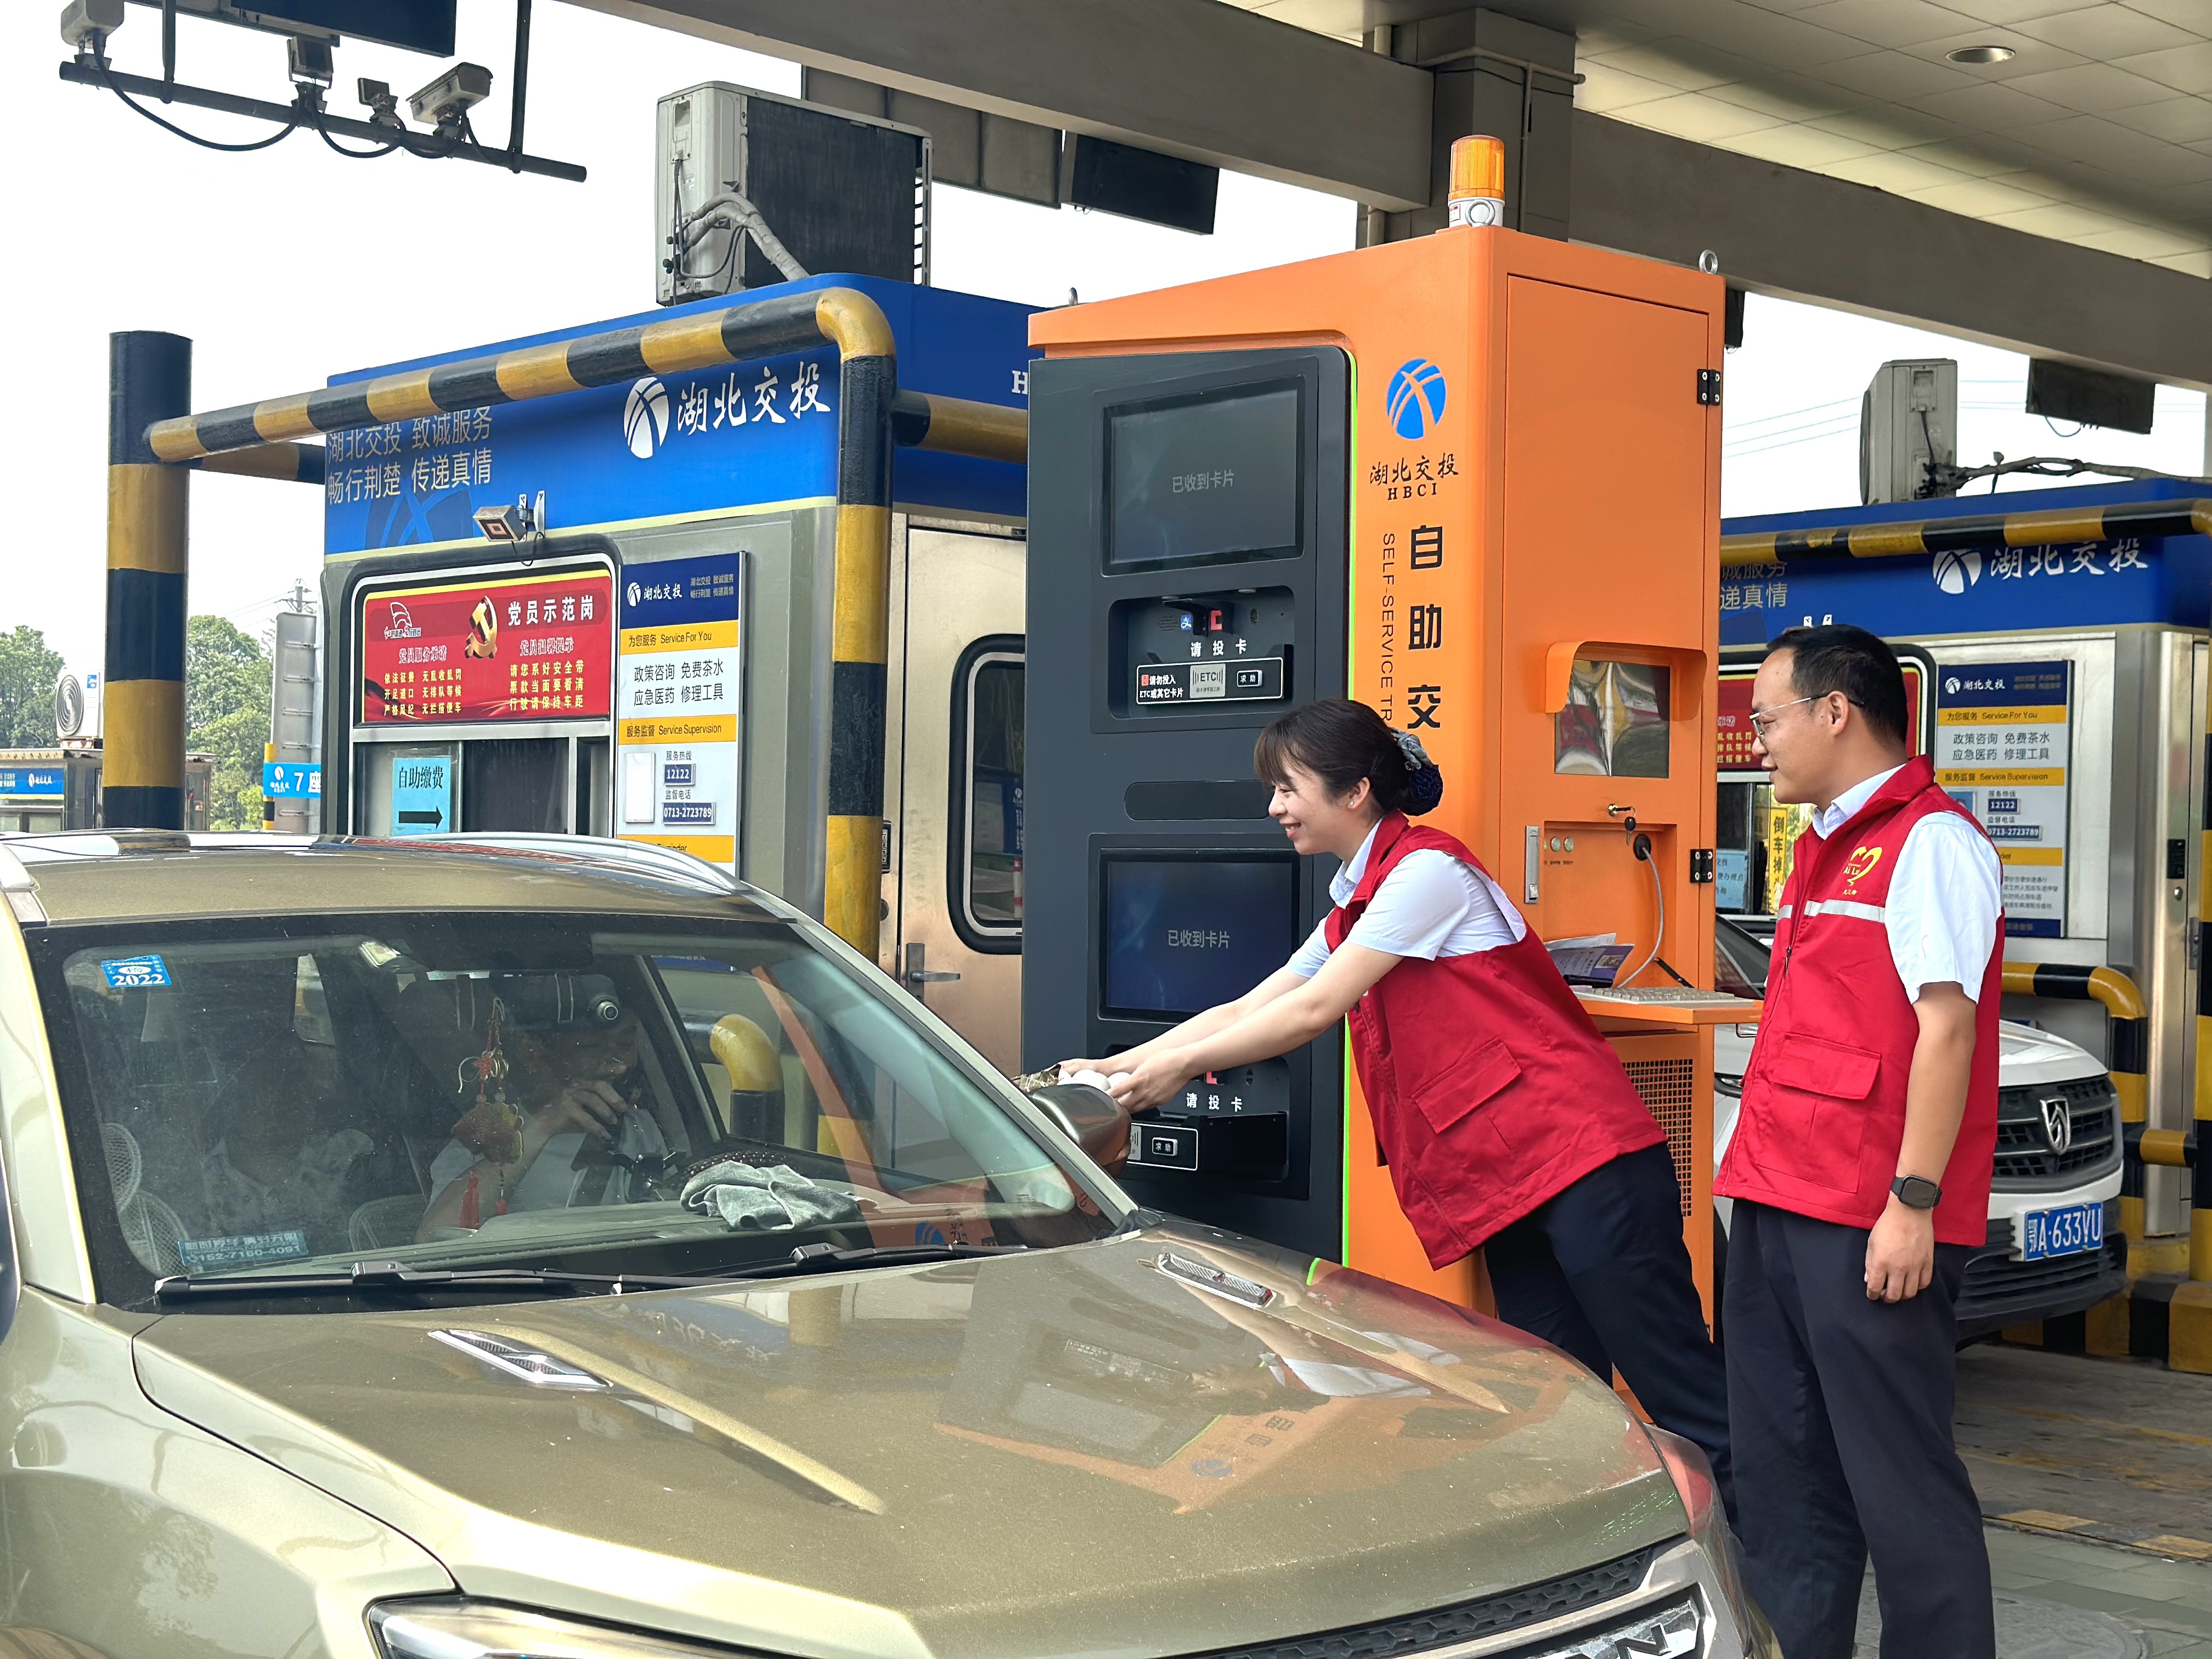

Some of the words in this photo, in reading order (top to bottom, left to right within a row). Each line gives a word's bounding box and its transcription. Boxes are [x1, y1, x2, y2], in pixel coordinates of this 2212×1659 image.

[678, 361, 831, 435] 湖北交投
[412, 406, 492, 449] 致诚服务
[328, 462, 401, 504] 畅行荆楚
[412, 448, 492, 493] 传递真情
[1370, 453, 1459, 486] 湖北交投
[1172, 469, 1235, 493] 已收到卡片
[1387, 483, 1437, 500] HBCI
[1990, 538, 2148, 580] 湖北交投
[644, 583, 682, 601] 湖北交投
[508, 595, 594, 626] 党员示范岗
[1381, 533, 1395, 689] SELF-SERVICE
[628, 634, 657, 647] 为您服务
[661, 633, 685, 644] Service
[686, 632, 696, 642] For
[698, 631, 712, 641] You
[510, 659, 584, 677] 请您系好安全带
[634, 663, 675, 682] 政策咨询
[681, 658, 724, 679] 免费茶水
[1200, 672, 1216, 682] ETC
[510, 695, 583, 711] 行驶请保持车距
[634, 687, 674, 707] 应急医药
[681, 683, 724, 703] 修理工具
[627, 725, 655, 737] 服务监督
[658, 725, 682, 735] Service
[684, 724, 722, 736] Supervision
[666, 751, 692, 761] 服务热线
[399, 765, 443, 789] 自助缴费
[667, 769, 689, 779] 12122
[2007, 773, 2048, 781] Supervision
[665, 789, 691, 799] 监督电话
[664, 808, 712, 818] 0713-2723789
[1168, 929, 1230, 949] 已收到卡片
[112, 974, 165, 985] 2022
